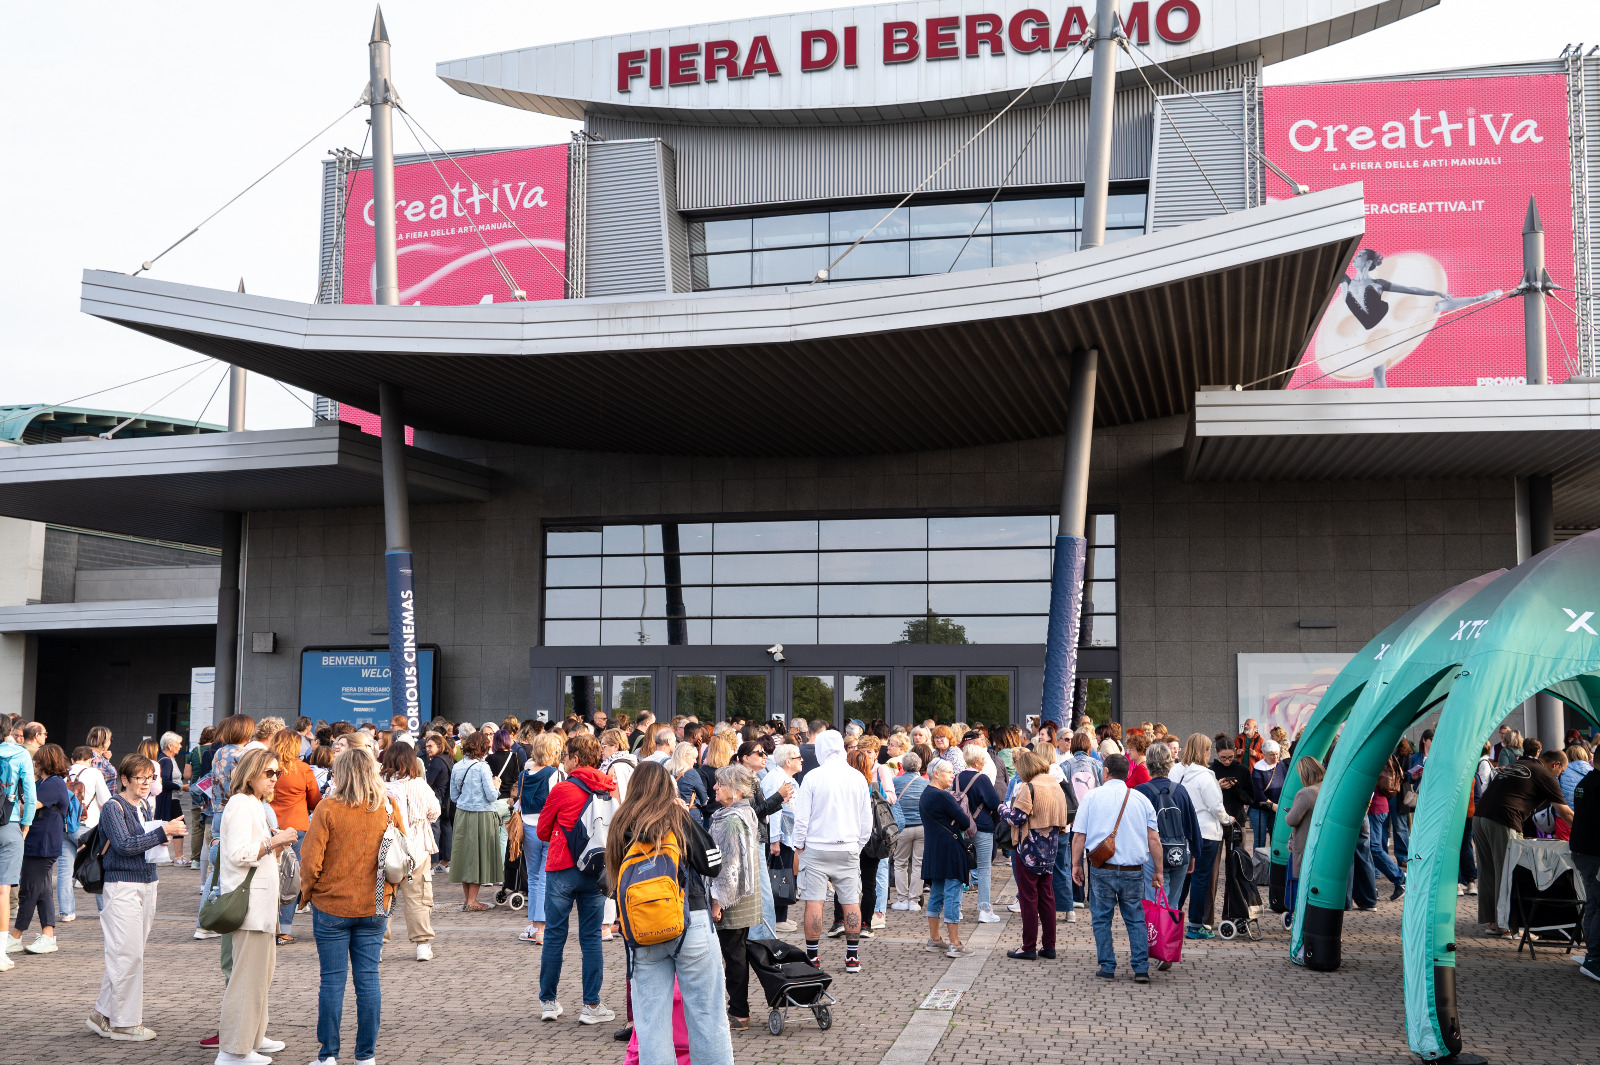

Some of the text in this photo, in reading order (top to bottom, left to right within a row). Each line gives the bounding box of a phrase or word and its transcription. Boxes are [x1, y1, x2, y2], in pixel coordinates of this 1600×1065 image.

[617, 0, 1202, 93] FIERA DI BERGAMO
[1333, 156, 1502, 171] LA FIERA DELLE ARTI MANUALI
[1364, 200, 1485, 215] ERACREATTIVA.IT
[405, 231, 429, 240] FIERA
[431, 228, 456, 237] DELLE
[401, 589, 417, 663] CINEMAS
[322, 656, 377, 666] BENVENUTI
[361, 668, 391, 678] WELC
[404, 666, 420, 740] TORIOUS
